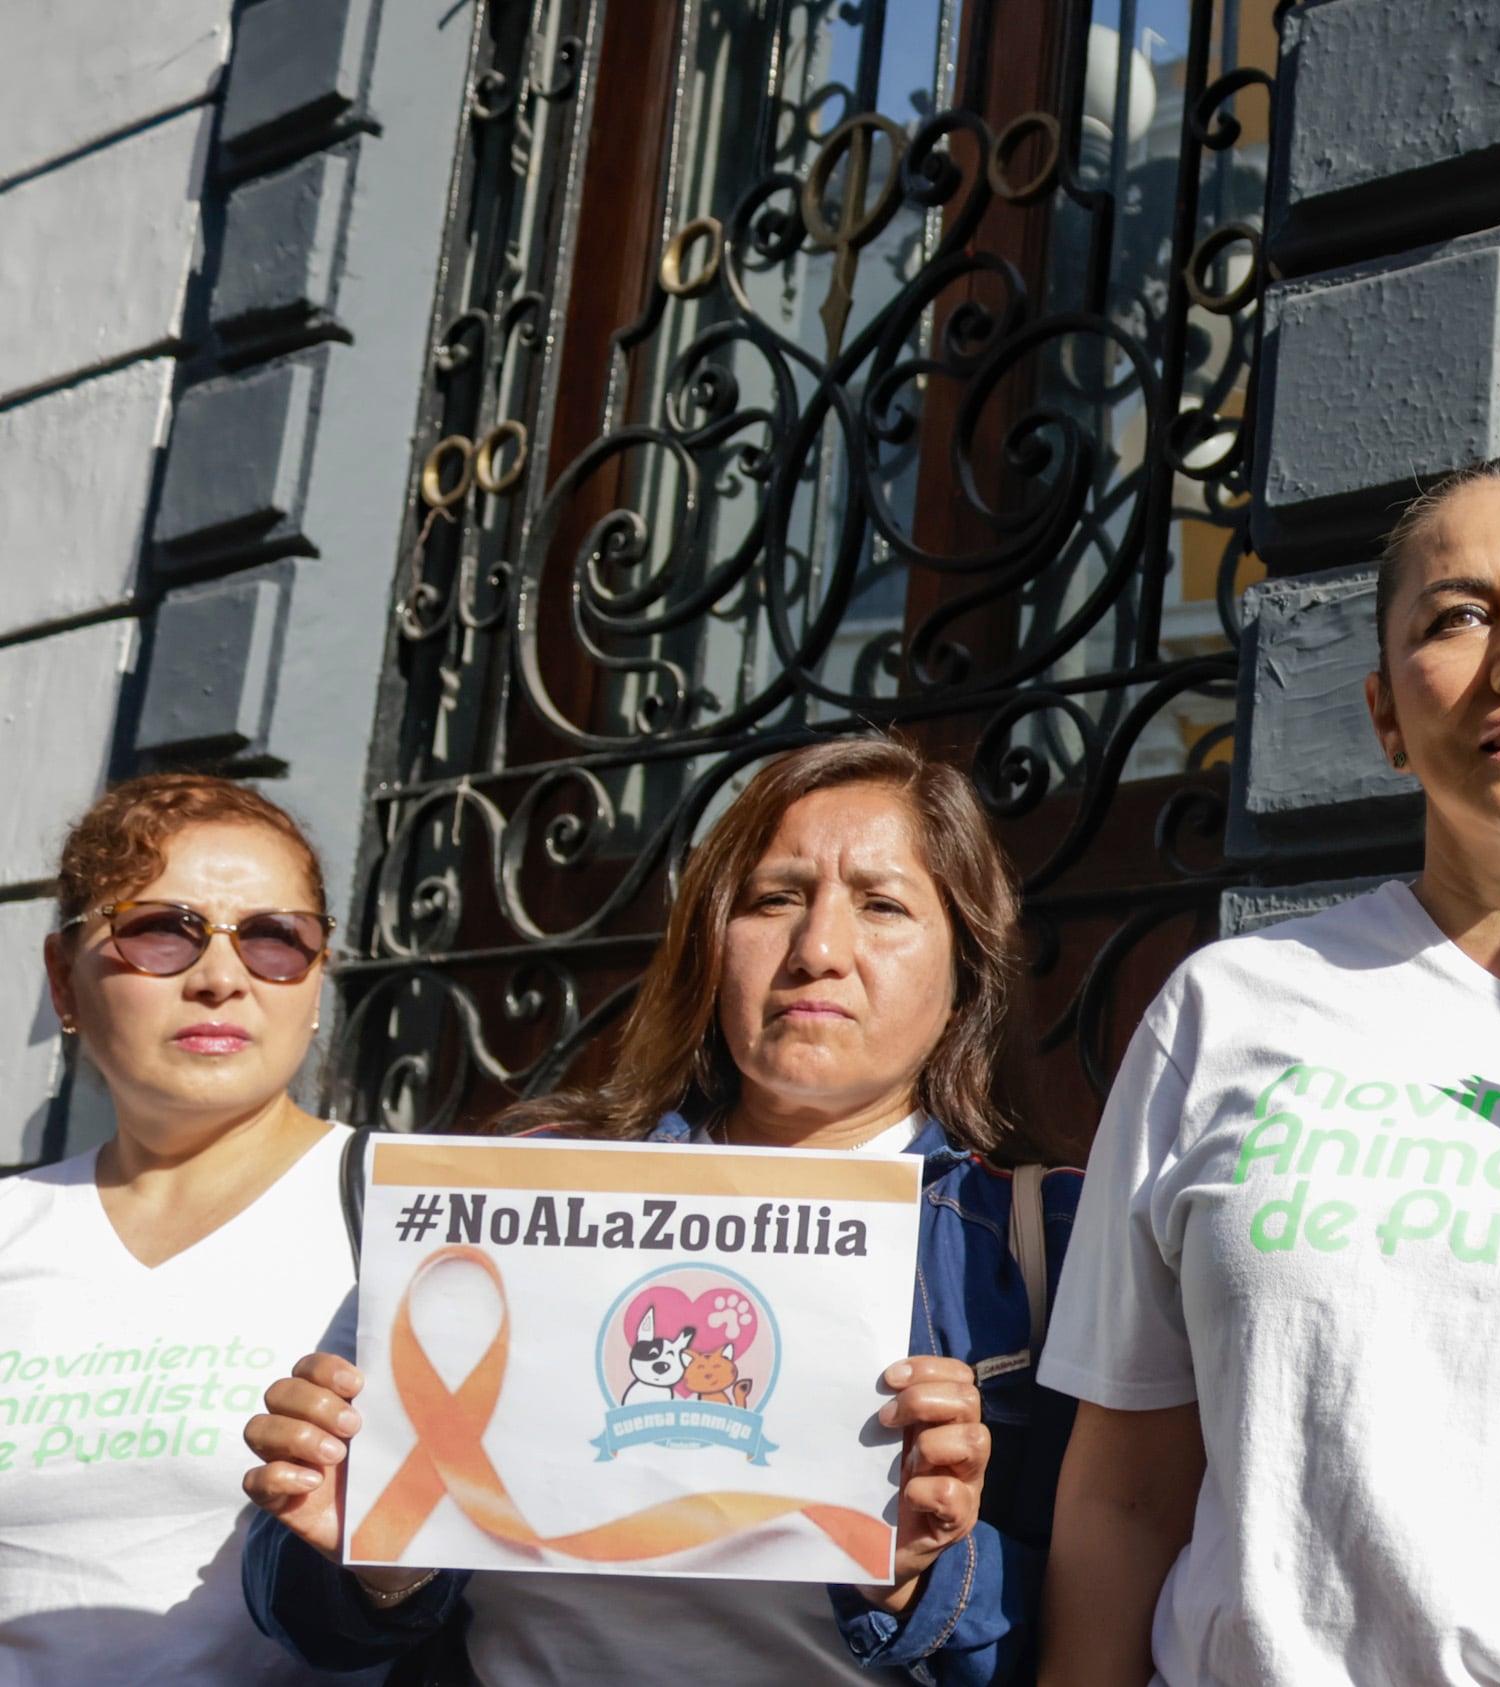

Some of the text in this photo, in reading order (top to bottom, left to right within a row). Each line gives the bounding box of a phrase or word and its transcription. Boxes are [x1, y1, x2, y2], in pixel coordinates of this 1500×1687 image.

[395, 1193, 867, 1256] #NoALaZoofilia
[1250, 1181, 1358, 1252] de
[33, 1415, 221, 1467] Puebla
[680, 1412, 752, 1440] conmigo
